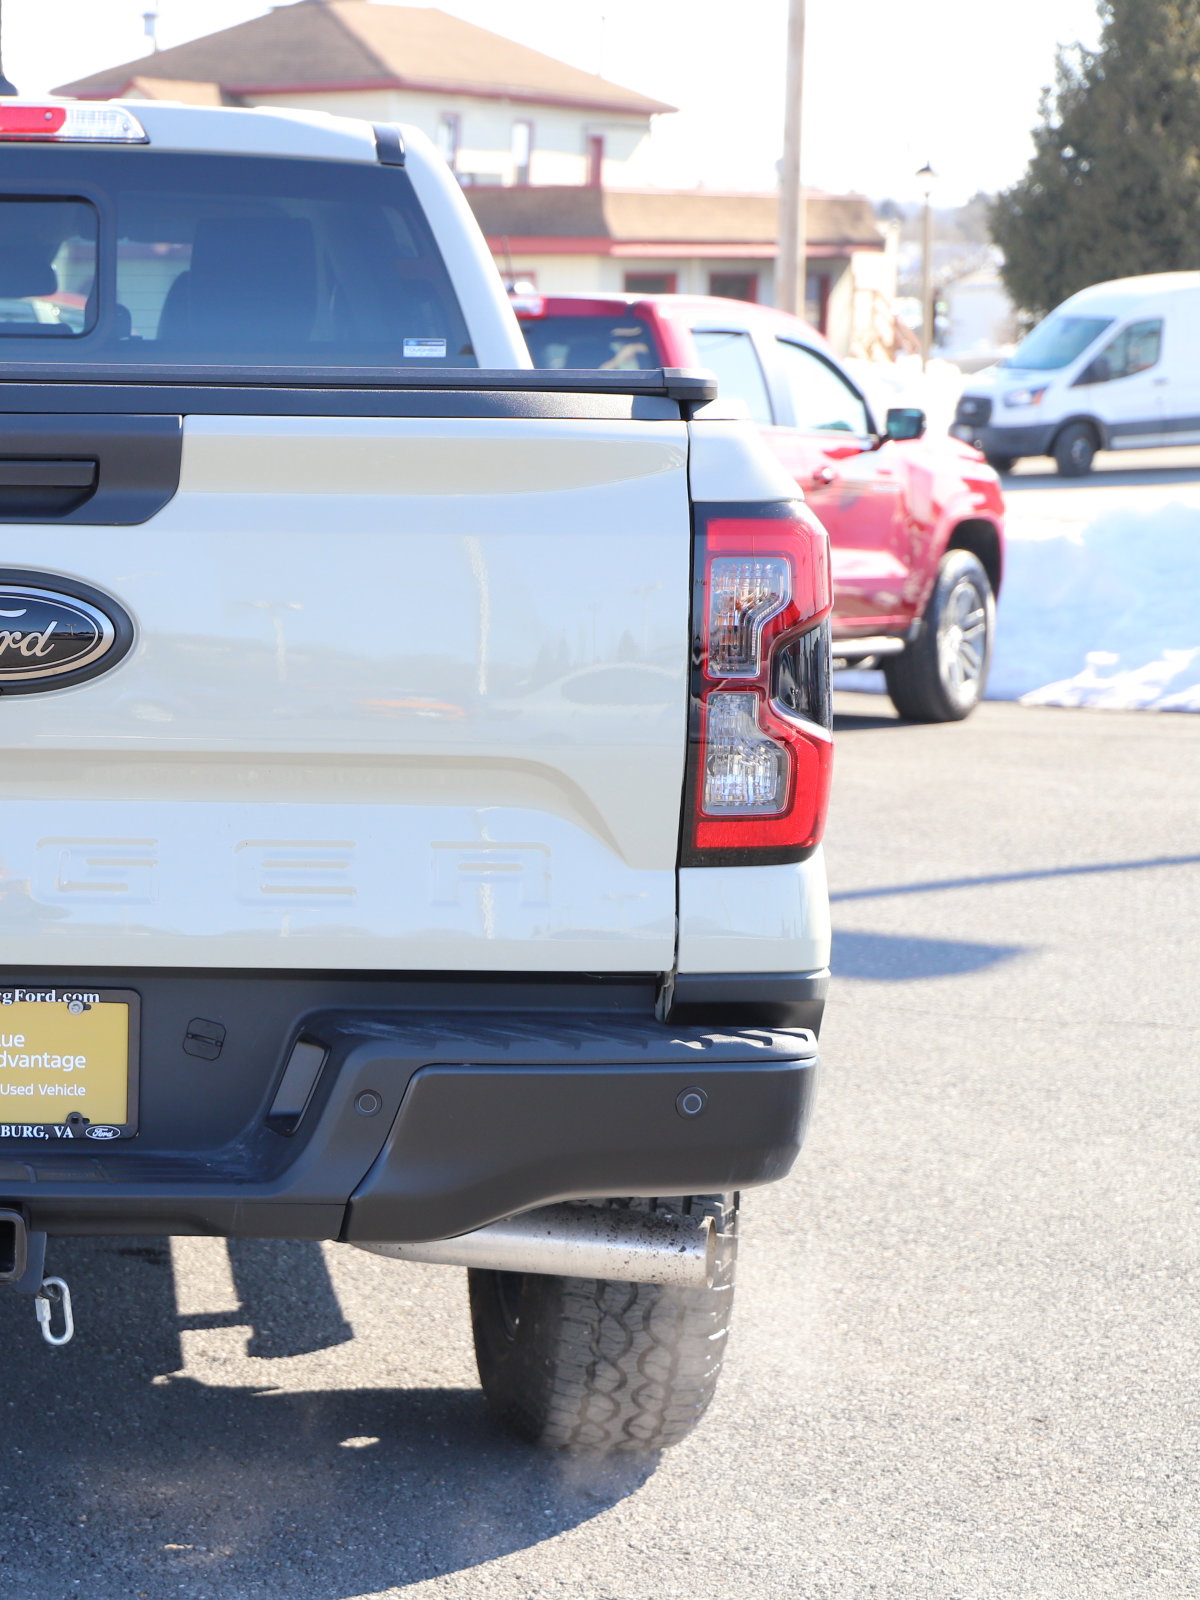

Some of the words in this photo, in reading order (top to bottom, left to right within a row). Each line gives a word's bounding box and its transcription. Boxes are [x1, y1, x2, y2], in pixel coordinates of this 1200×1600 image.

[0, 1083, 34, 1096] Used
[38, 1084, 86, 1097] Vehicle
[54, 1126, 74, 1139] VA
[92, 1128, 115, 1138] Ford
